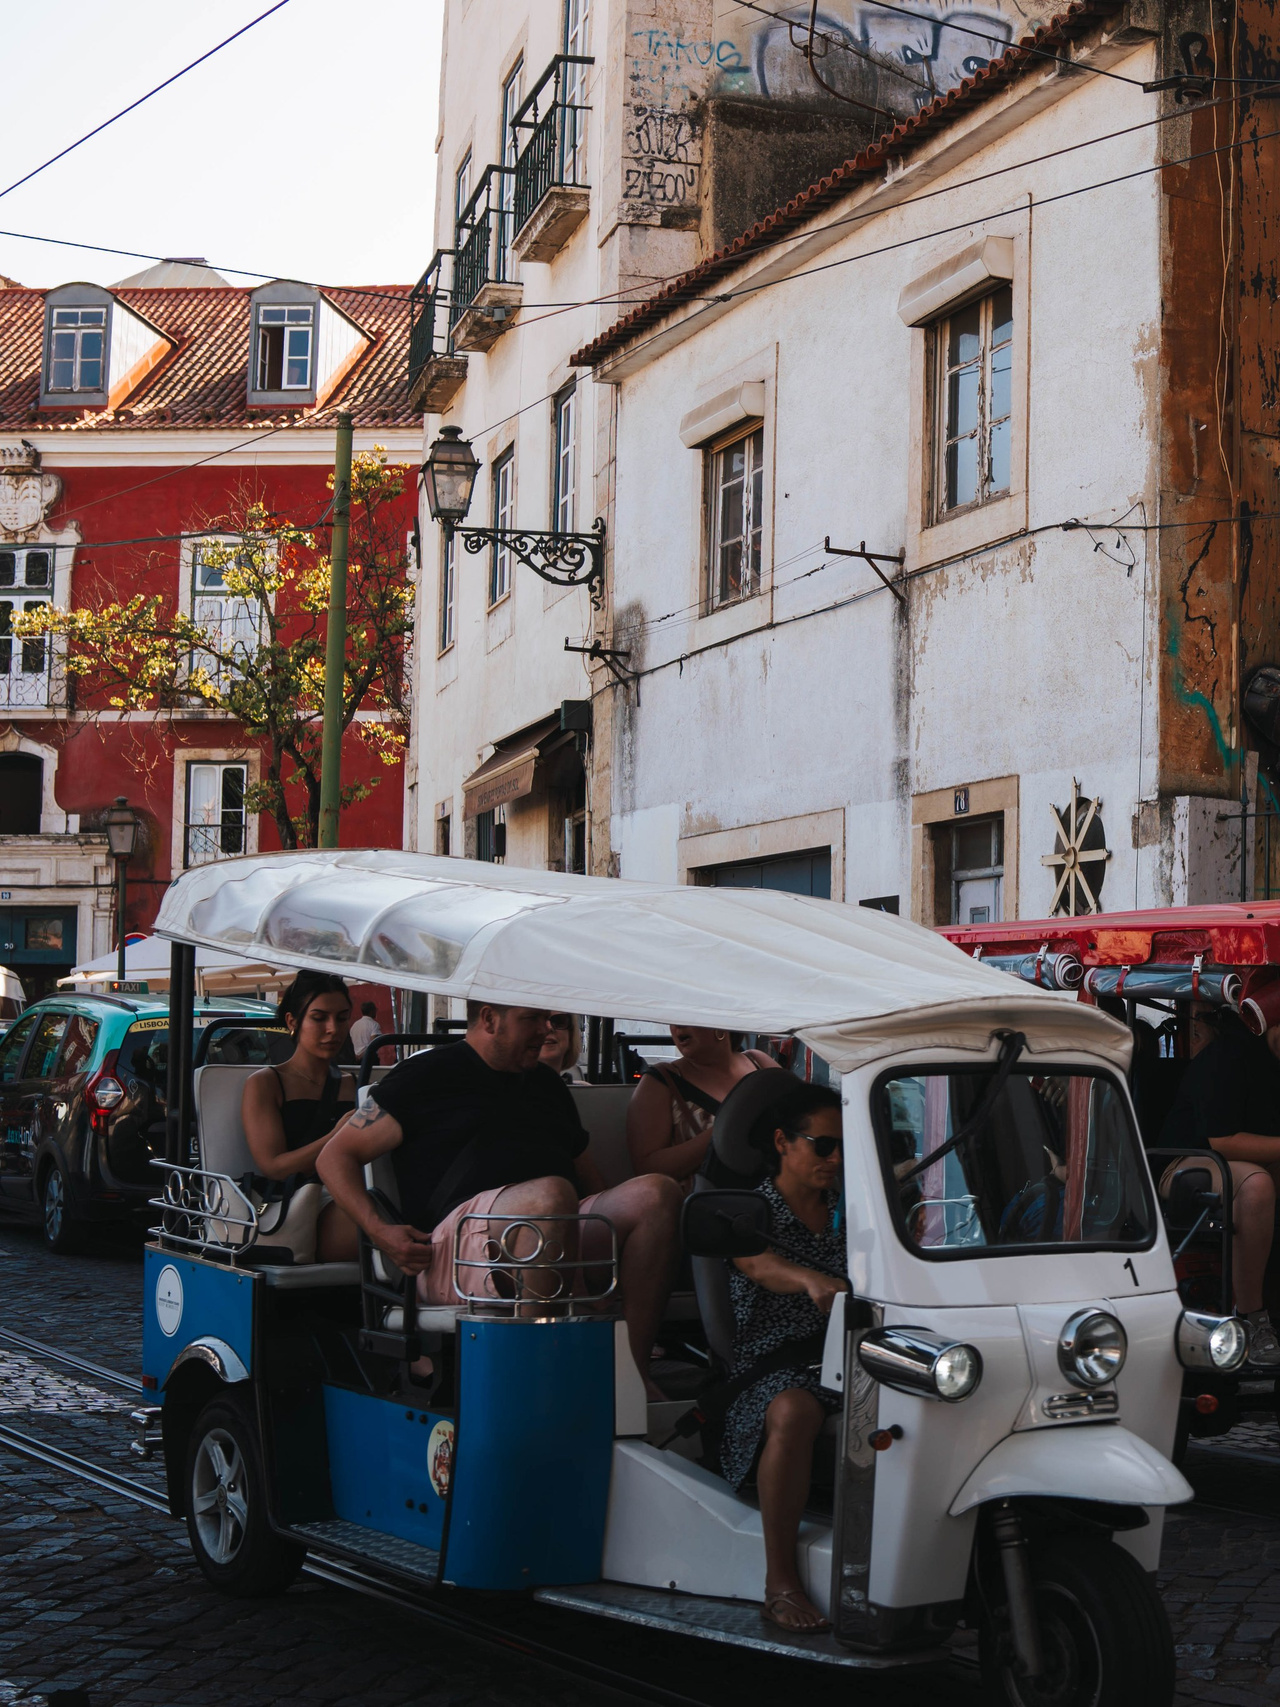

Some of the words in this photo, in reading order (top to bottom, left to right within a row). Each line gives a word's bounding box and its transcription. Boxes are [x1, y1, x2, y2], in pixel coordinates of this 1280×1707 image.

[956, 790, 965, 811] 78
[120, 982, 140, 992] TAXI
[140, 1020, 169, 1029] LISBOA
[1123, 1257, 1140, 1287] 1
